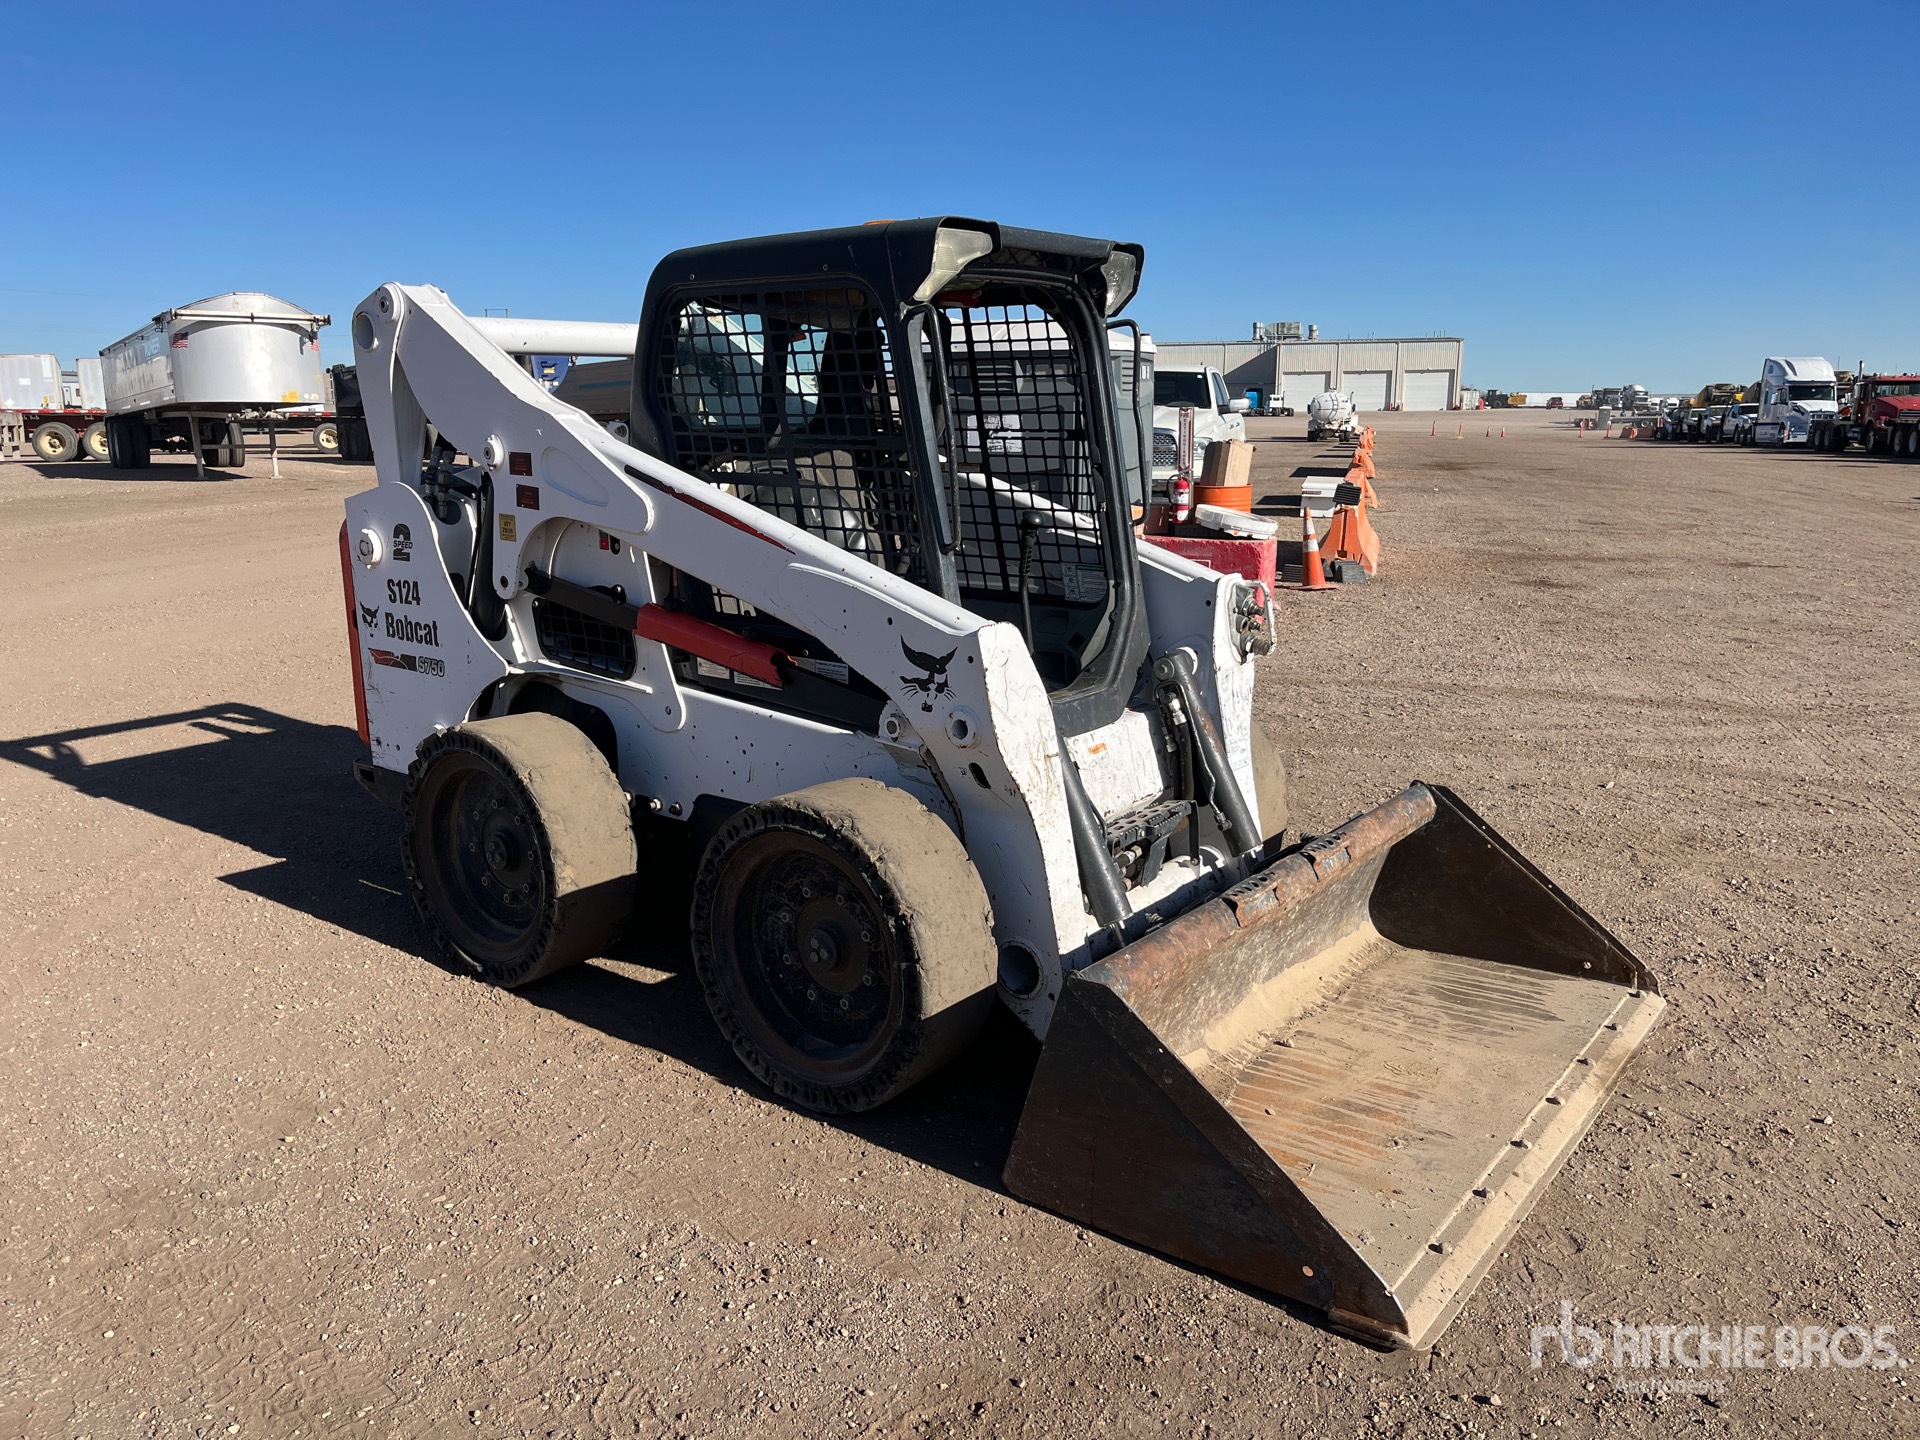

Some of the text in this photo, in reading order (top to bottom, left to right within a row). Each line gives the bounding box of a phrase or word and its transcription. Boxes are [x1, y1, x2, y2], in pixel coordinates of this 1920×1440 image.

[393, 539, 413, 549] SPEED
[387, 578, 421, 606] S124
[385, 612, 439, 647] Bobcat
[417, 655, 446, 678] S750
